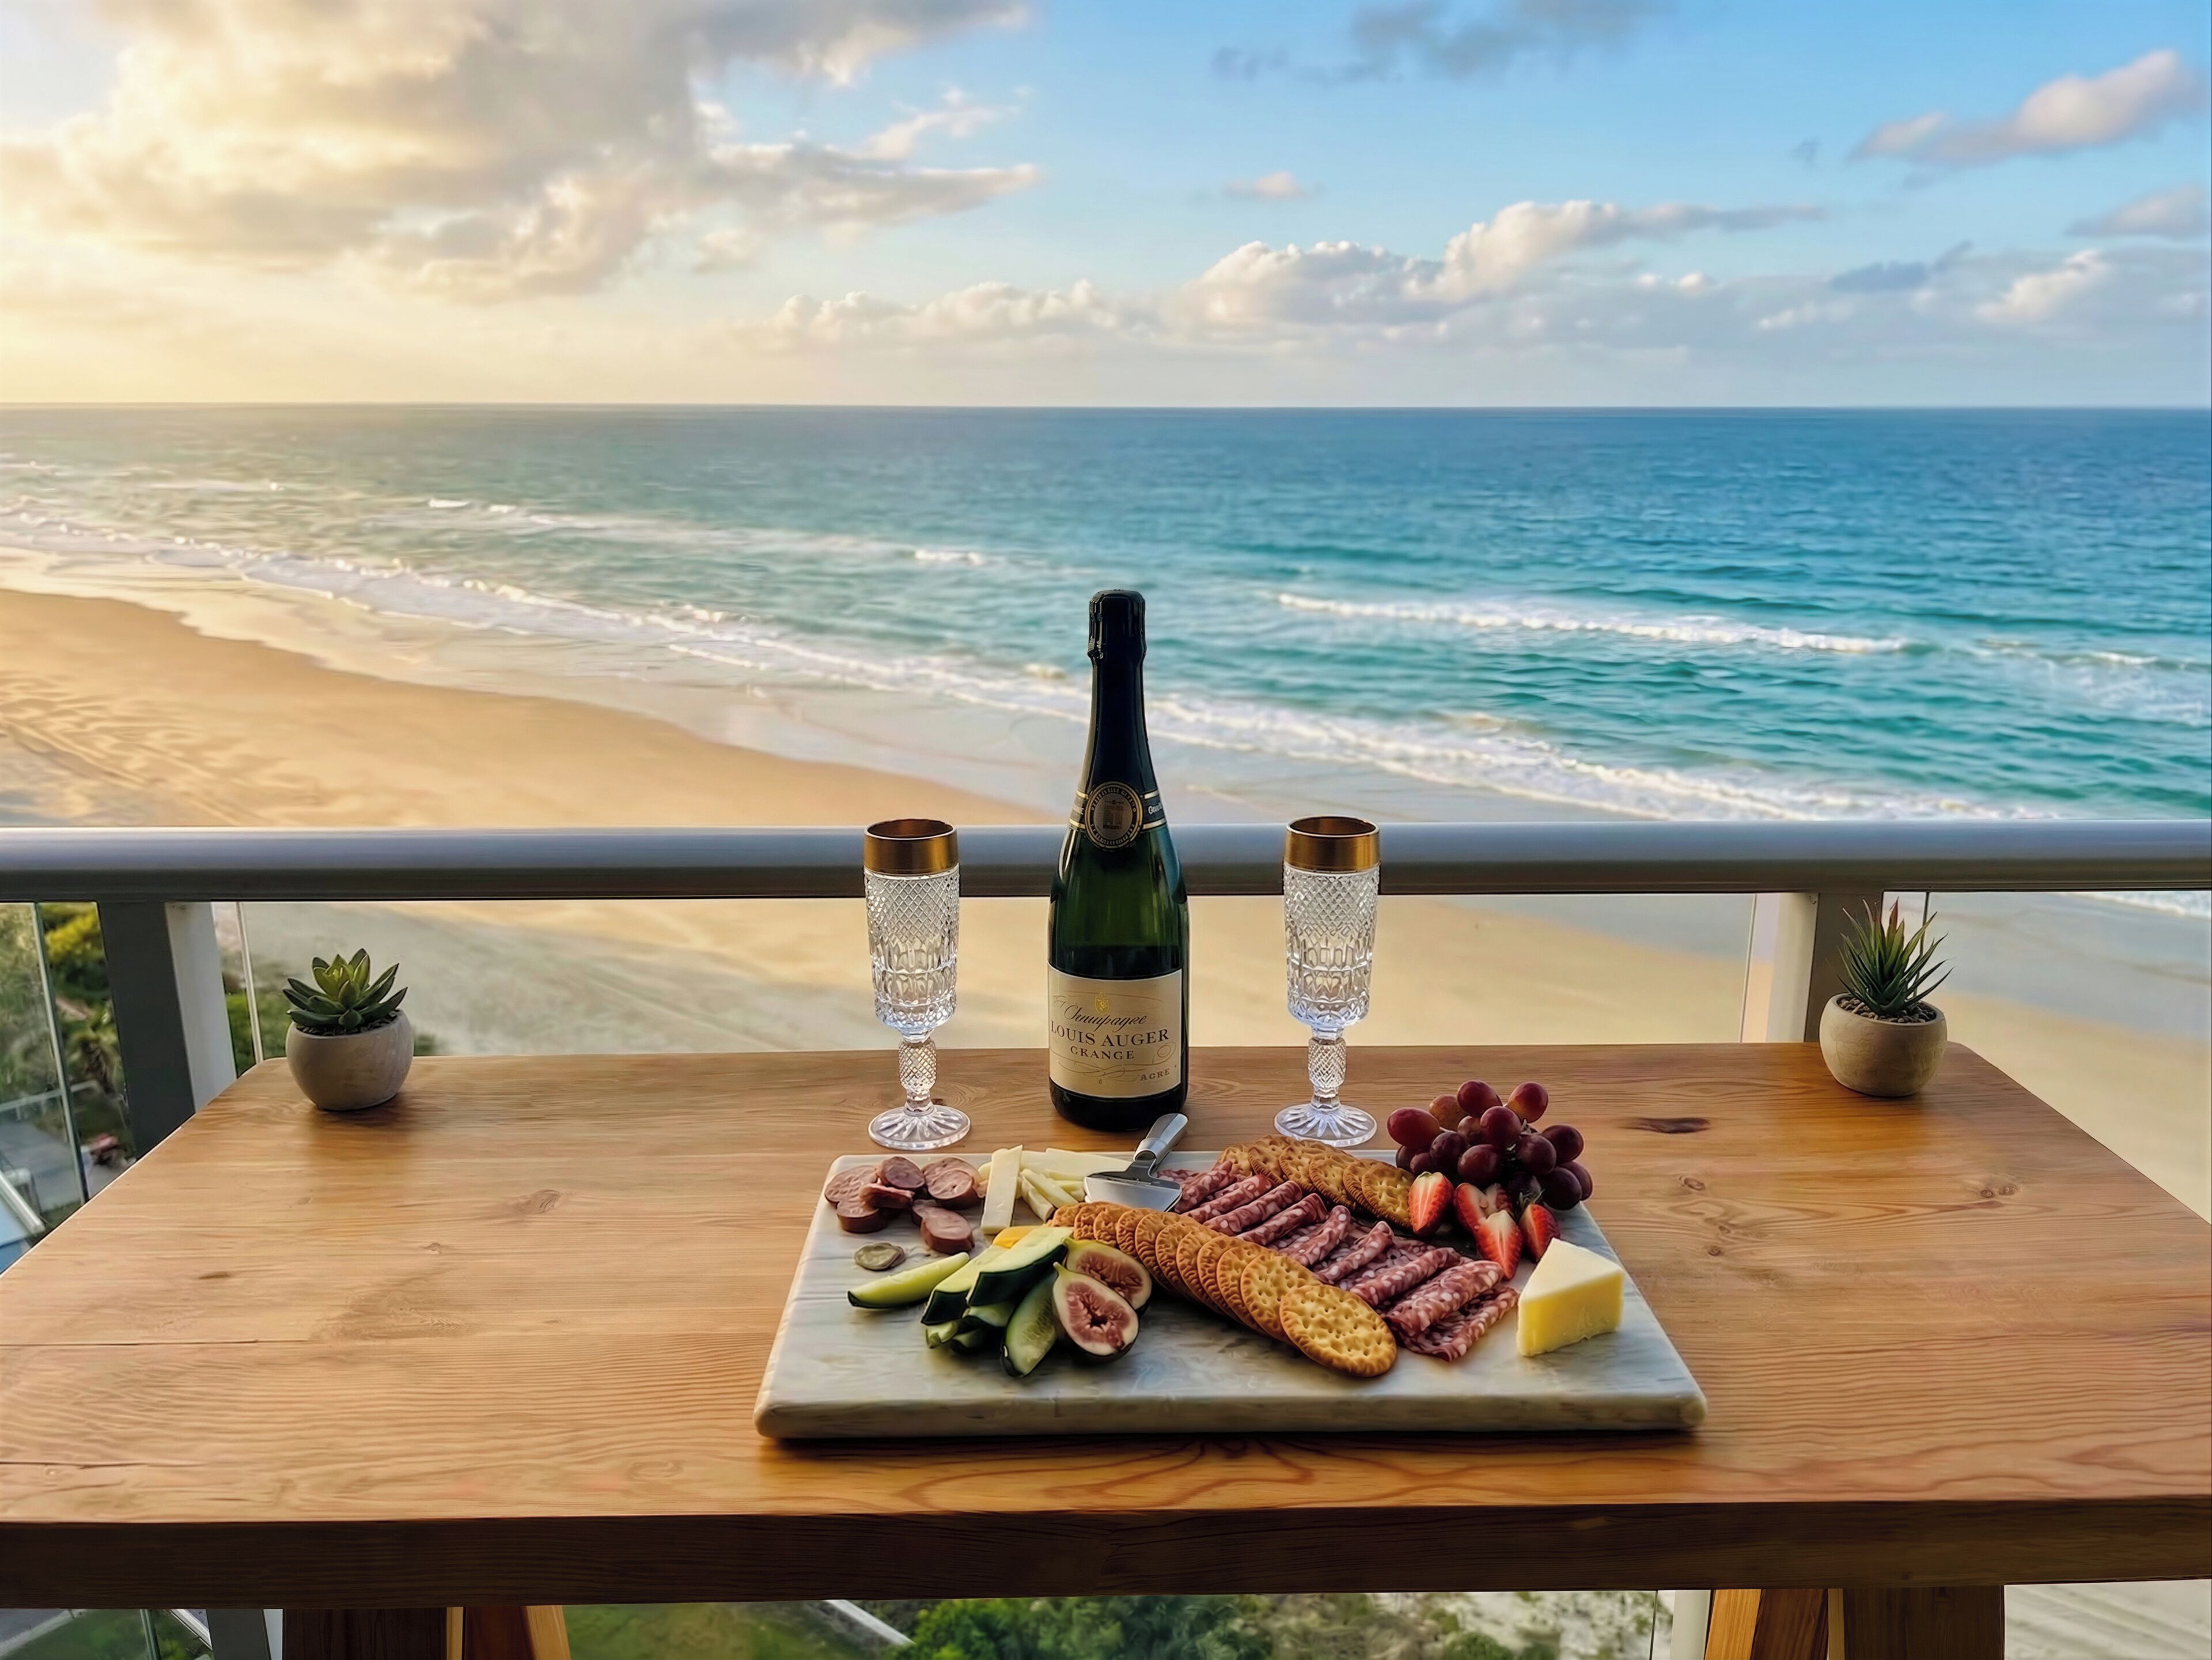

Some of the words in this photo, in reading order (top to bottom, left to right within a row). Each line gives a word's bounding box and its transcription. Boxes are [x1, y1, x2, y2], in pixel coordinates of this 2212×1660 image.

[1051, 1019, 1095, 1046] LOUIS
[1101, 1028, 1169, 1047] AUGER
[1070, 1046, 1135, 1060] GRANGE
